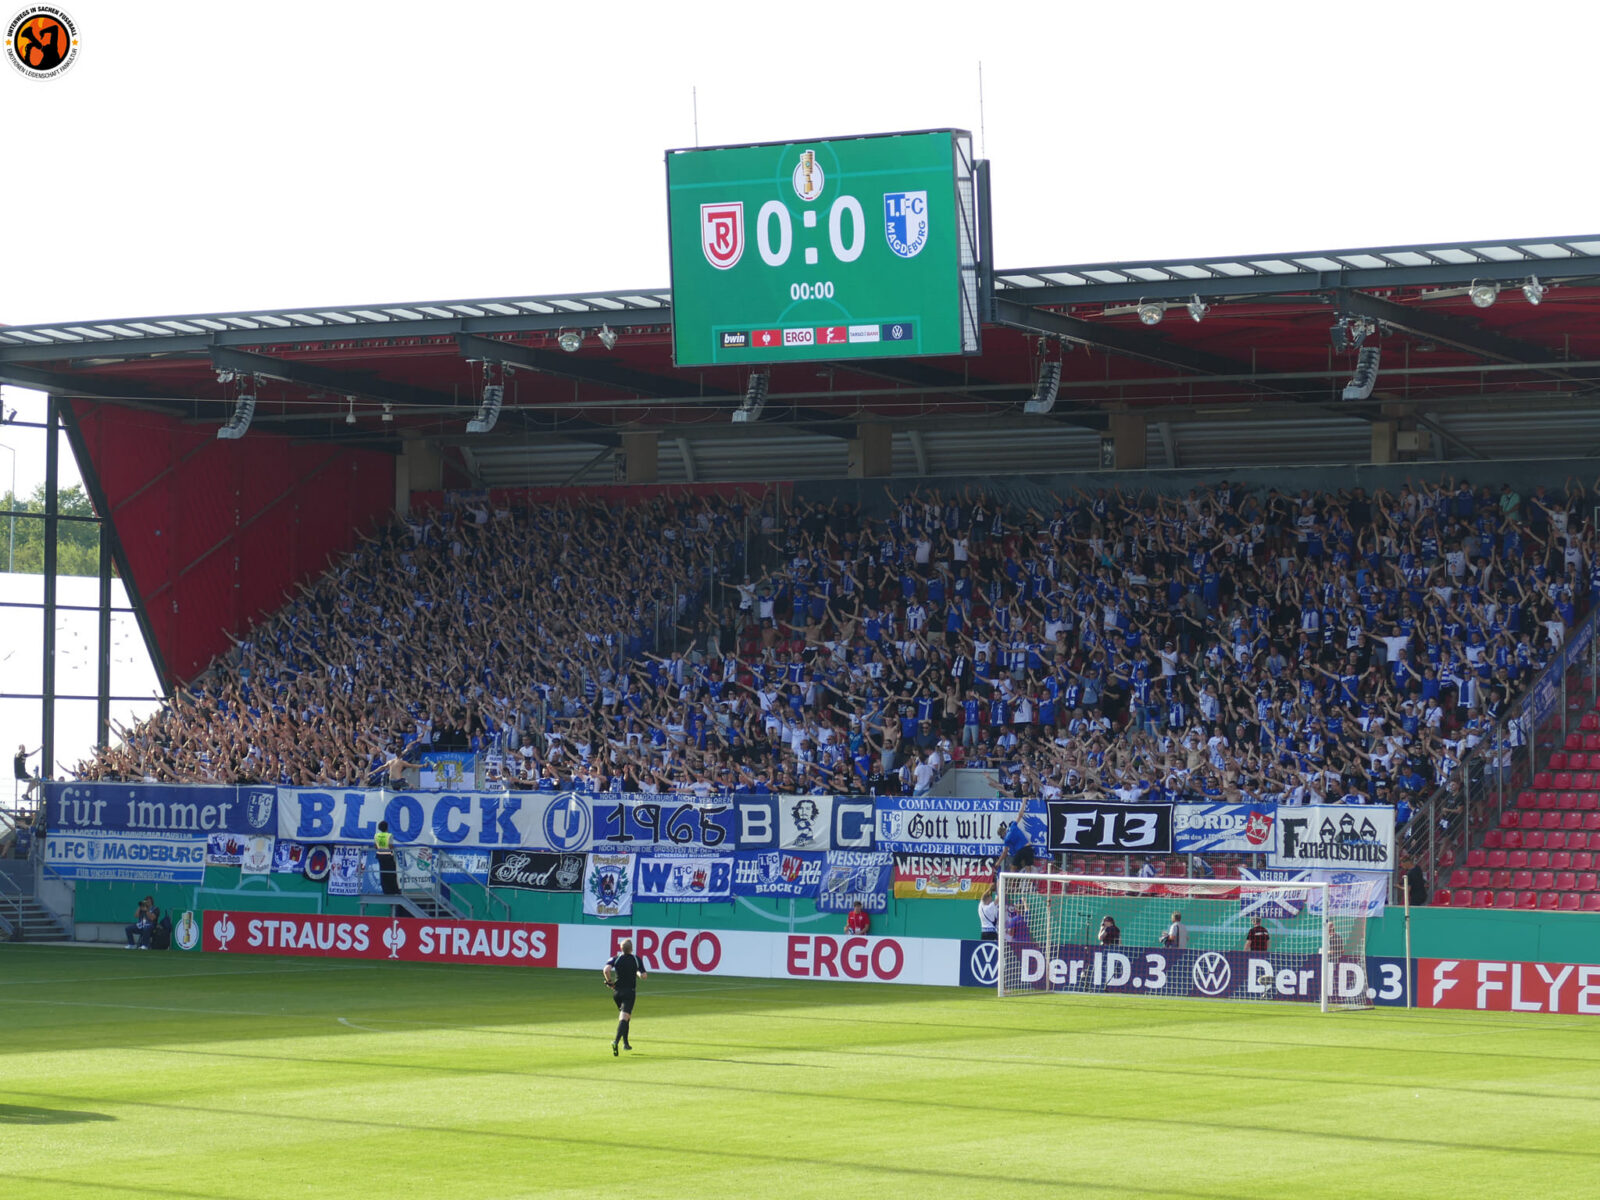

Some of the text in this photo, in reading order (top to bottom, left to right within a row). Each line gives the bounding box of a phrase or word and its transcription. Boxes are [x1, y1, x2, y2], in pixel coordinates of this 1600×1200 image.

[887, 220, 926, 254] MAGDEBURG
[790, 281, 834, 300] 00:00
[724, 332, 745, 343] bwin
[786, 331, 812, 343] ERGO
[58, 787, 108, 828] für
[127, 791, 233, 830] immer
[296, 792, 522, 845] BLOCK
[899, 798, 1030, 812] COMMANDO EAST SIDE
[606, 802, 727, 847] 1965
[739, 803, 773, 844] B
[836, 804, 875, 847] G
[908, 813, 949, 840] Gott
[956, 813, 992, 840] will
[1060, 809, 1159, 847] FI3
[1175, 809, 1248, 830] BÖRDE
[47, 840, 204, 863] 1.FC MAGDEBURG
[826, 850, 895, 867] WEISSENFELS
[877, 842, 899, 852] 1.FC
[902, 843, 976, 855] MAGDEBURG
[641, 862, 730, 893] W B
[896, 856, 995, 876] WEISSENFELS
[756, 883, 803, 895] BLOCK U
[820, 892, 887, 910] PIRANHAS
[247, 920, 548, 960] STRAUSS STRAUSS
[610, 928, 904, 981] ERGO ERGO
[1020, 948, 1167, 989] Der ID.3
[1247, 958, 1403, 1001] Der ID.3
